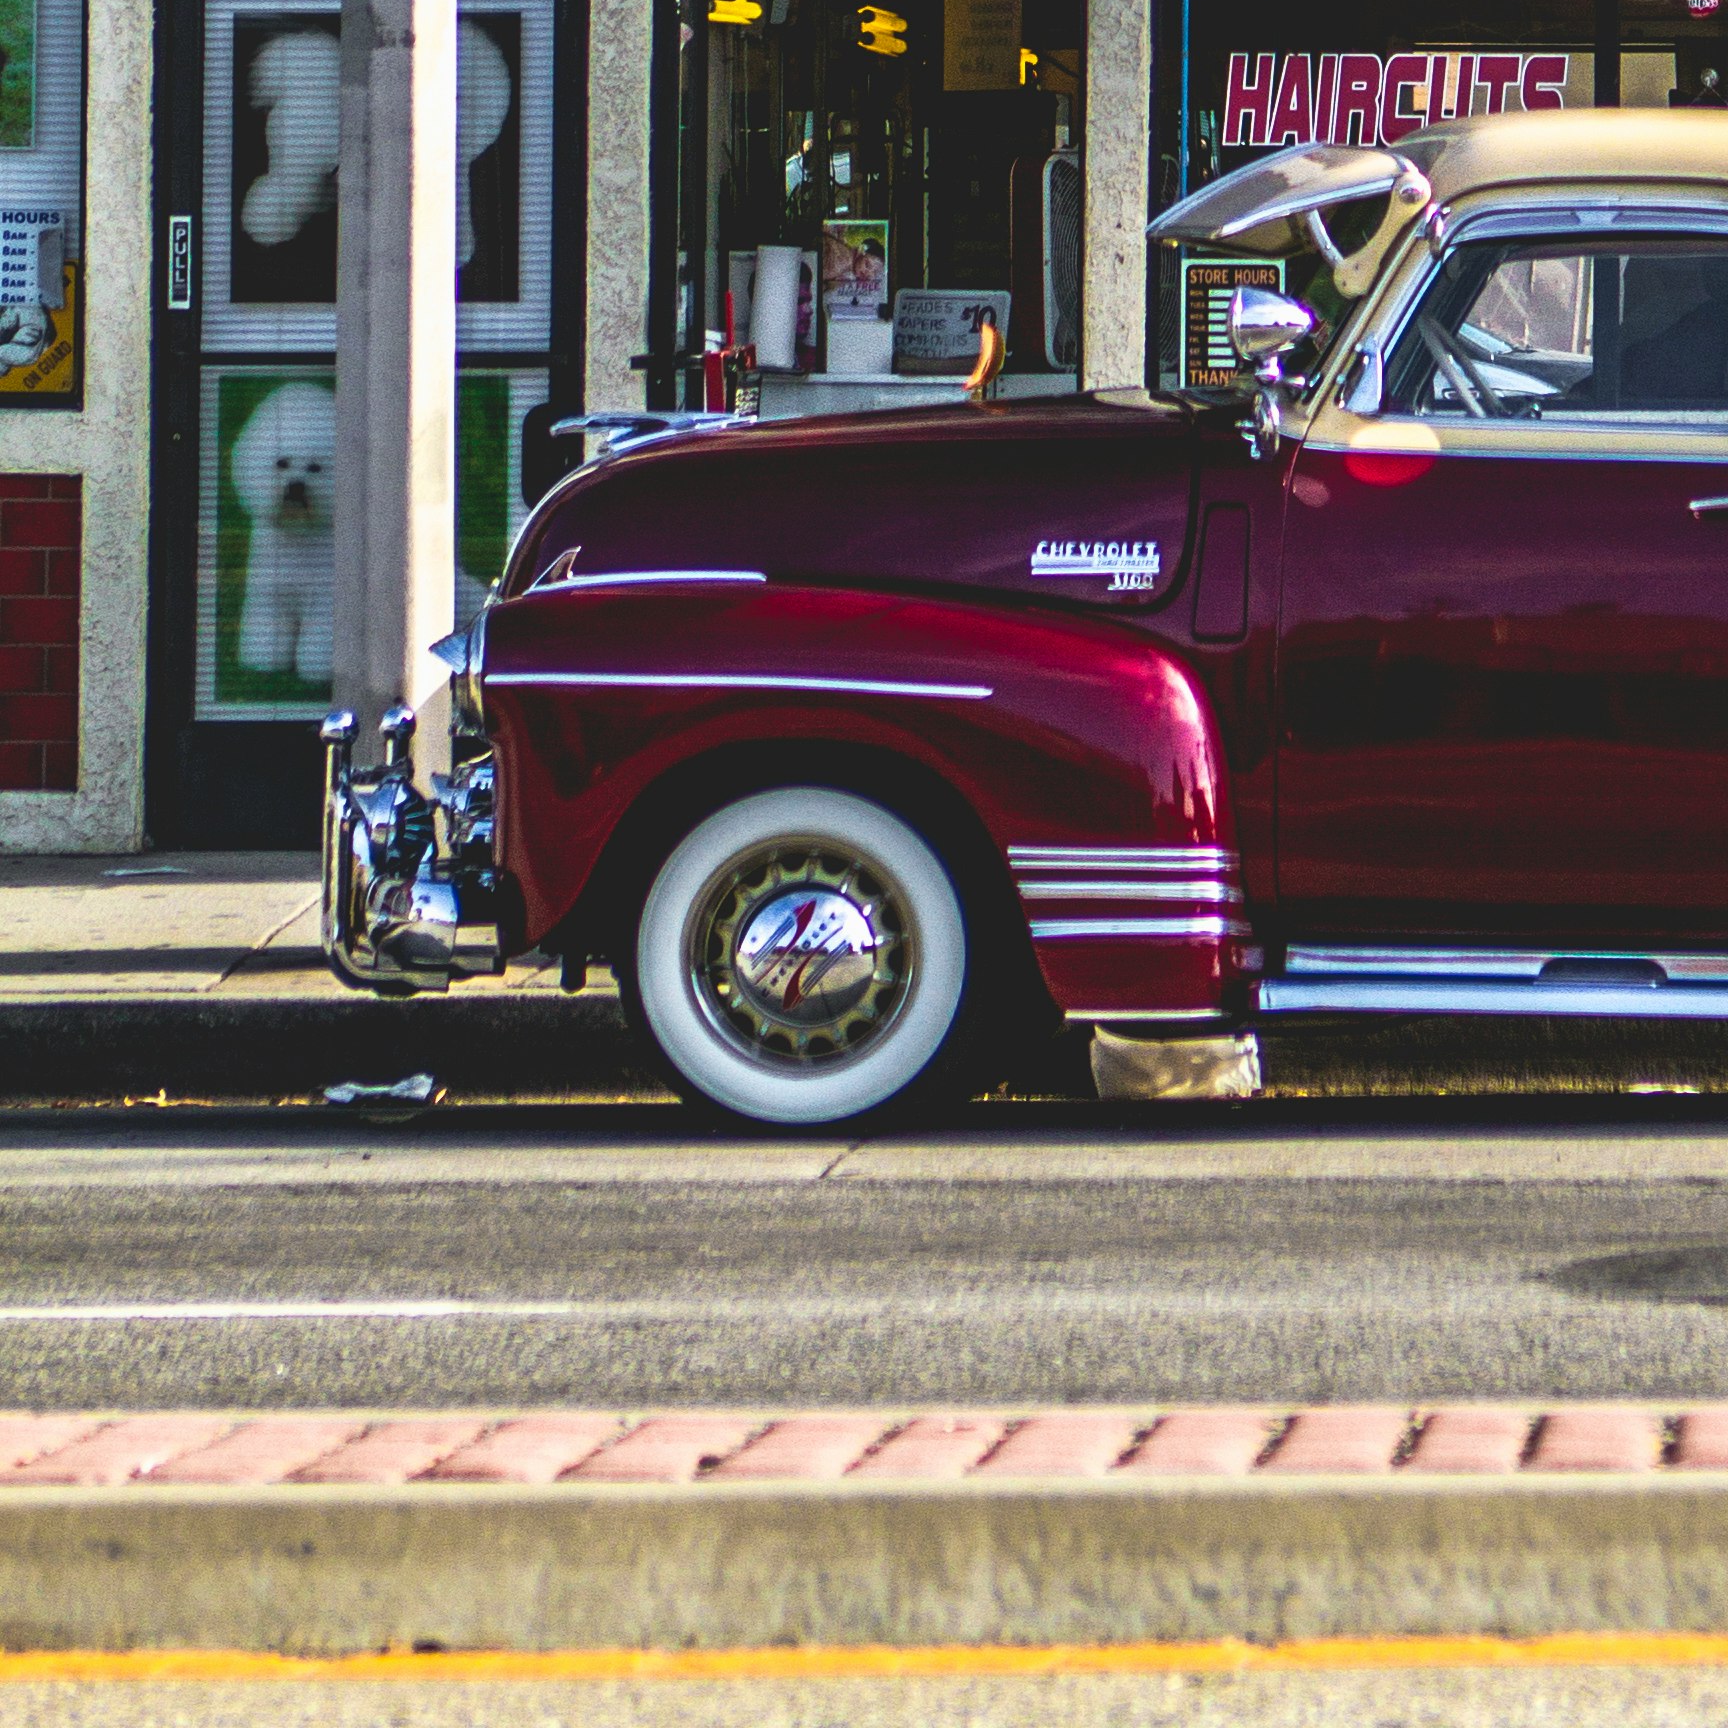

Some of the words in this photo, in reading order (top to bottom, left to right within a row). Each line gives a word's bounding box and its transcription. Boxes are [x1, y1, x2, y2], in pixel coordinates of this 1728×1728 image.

[1222, 52, 1570, 147] HAIRCUTS
[2, 211, 60, 224] HOURS
[174, 228, 187, 283] PULL
[1190, 269, 1229, 284] STORE
[1234, 269, 1276, 284] HOURS
[23, 370, 42, 389] ON
[38, 339, 73, 376] GUARD
[1035, 540, 1158, 558] CHEVROLET
